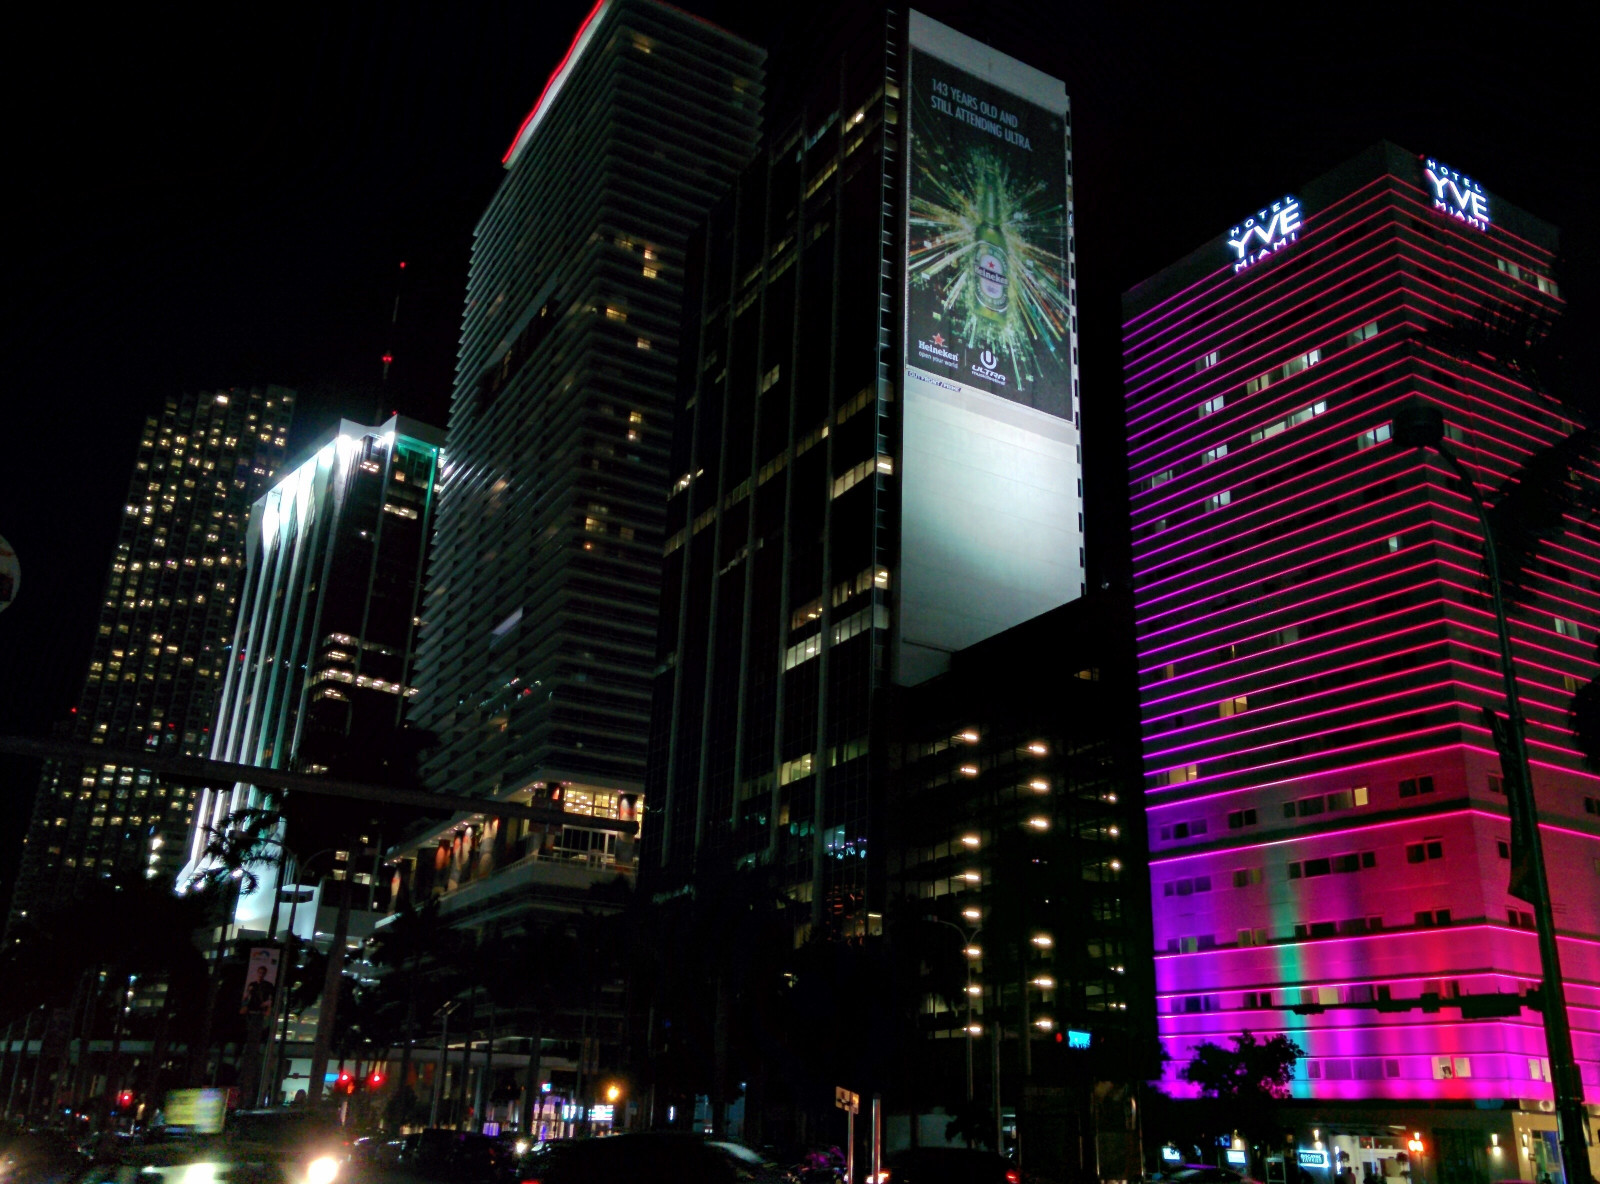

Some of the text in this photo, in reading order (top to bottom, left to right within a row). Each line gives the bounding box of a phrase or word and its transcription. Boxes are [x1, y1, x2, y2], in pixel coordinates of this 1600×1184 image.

[931, 95, 953, 114] STILL
[955, 107, 1002, 138] ATTENDING
[932, 79, 1018, 128] 143 YEARS OLD AND
[1424, 168, 1490, 222] YVE
[1427, 159, 1482, 194] HOTEL
[1227, 202, 1302, 259] YVE
[1230, 196, 1295, 237] HOTEL
[1434, 198, 1486, 232] MIAMI
[1234, 232, 1296, 273] MIAMI
[918, 339, 959, 362] Heineken
[971, 364, 1006, 382] ULTRA
